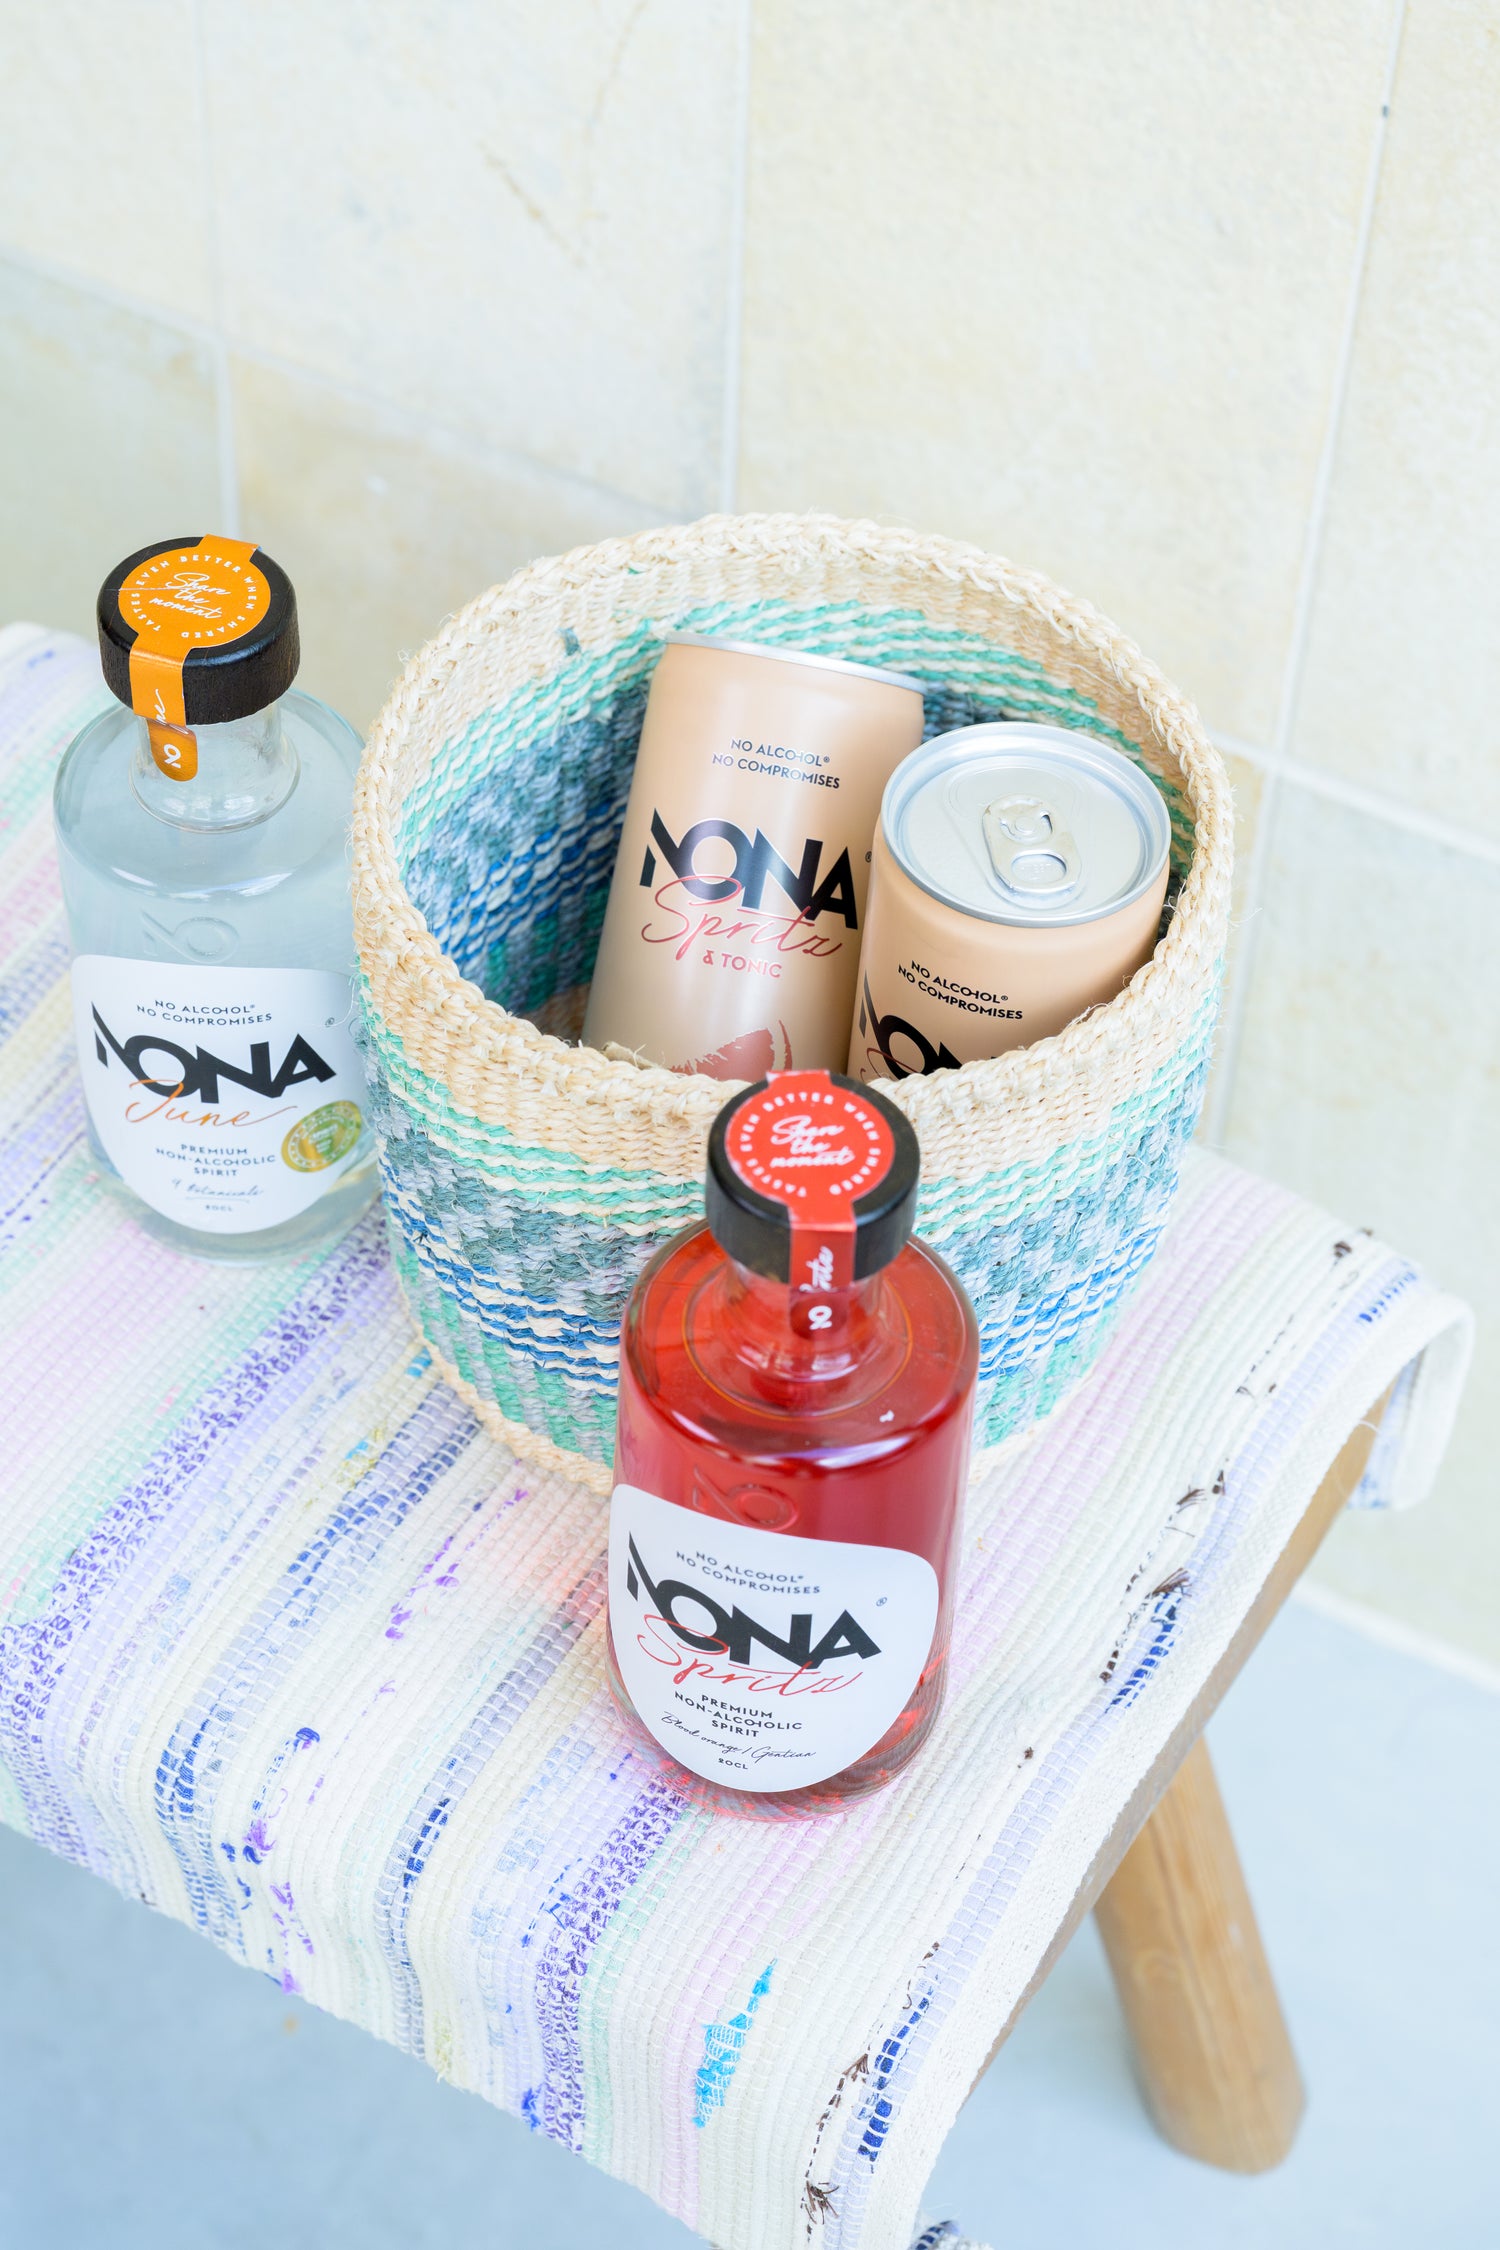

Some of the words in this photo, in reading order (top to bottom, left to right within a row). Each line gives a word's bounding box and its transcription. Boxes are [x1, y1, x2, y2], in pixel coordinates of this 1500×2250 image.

[135, 560, 170, 586] EVEN
[180, 554, 241, 573] BETTER
[164, 572, 232, 595] Share
[174, 588, 210, 604] the
[243, 576, 257, 610] WHEN
[131, 592, 162, 632] TASTES
[148, 597, 223, 619] moment
[181, 615, 246, 638] SHARED
[731, 738, 753, 753] NO
[712, 753, 734, 767] NO
[737, 758, 841, 789] COMPROMISES
[640, 807, 858, 930] NONA
[641, 874, 843, 961] Spritz
[702, 949, 715, 966] &
[721, 953, 783, 979] TONIC
[911, 960, 931, 979] NO
[898, 964, 916, 984] NO
[917, 980, 1023, 1020] COMPROMISES
[136, 1004, 157, 1017] NO
[161, 1012, 273, 1026] COMPROMISES
[154, 999, 176, 1011] NO
[91, 1001, 338, 1105] NONA
[125, 1079, 298, 1127] June
[155, 1148, 276, 1166] NON-ALCOHOLIC
[180, 1143, 248, 1155] PREMIUM
[194, 1166, 238, 1176] SPIRIT
[695, 1551, 718, 1566] NO
[676, 1551, 697, 1567] NO
[701, 1566, 821, 1594] COMPROMISES
[627, 1530, 882, 1669] NONA
[637, 1614, 863, 1696] Spritz
[674, 1691, 803, 1730] NON-ALCOHOLIC
[701, 1694, 773, 1719] PREMIUM
[660, 1711, 701, 1737] Blood
[701, 1736, 743, 1754] orange
[711, 1719, 760, 1738] SPIRIT
